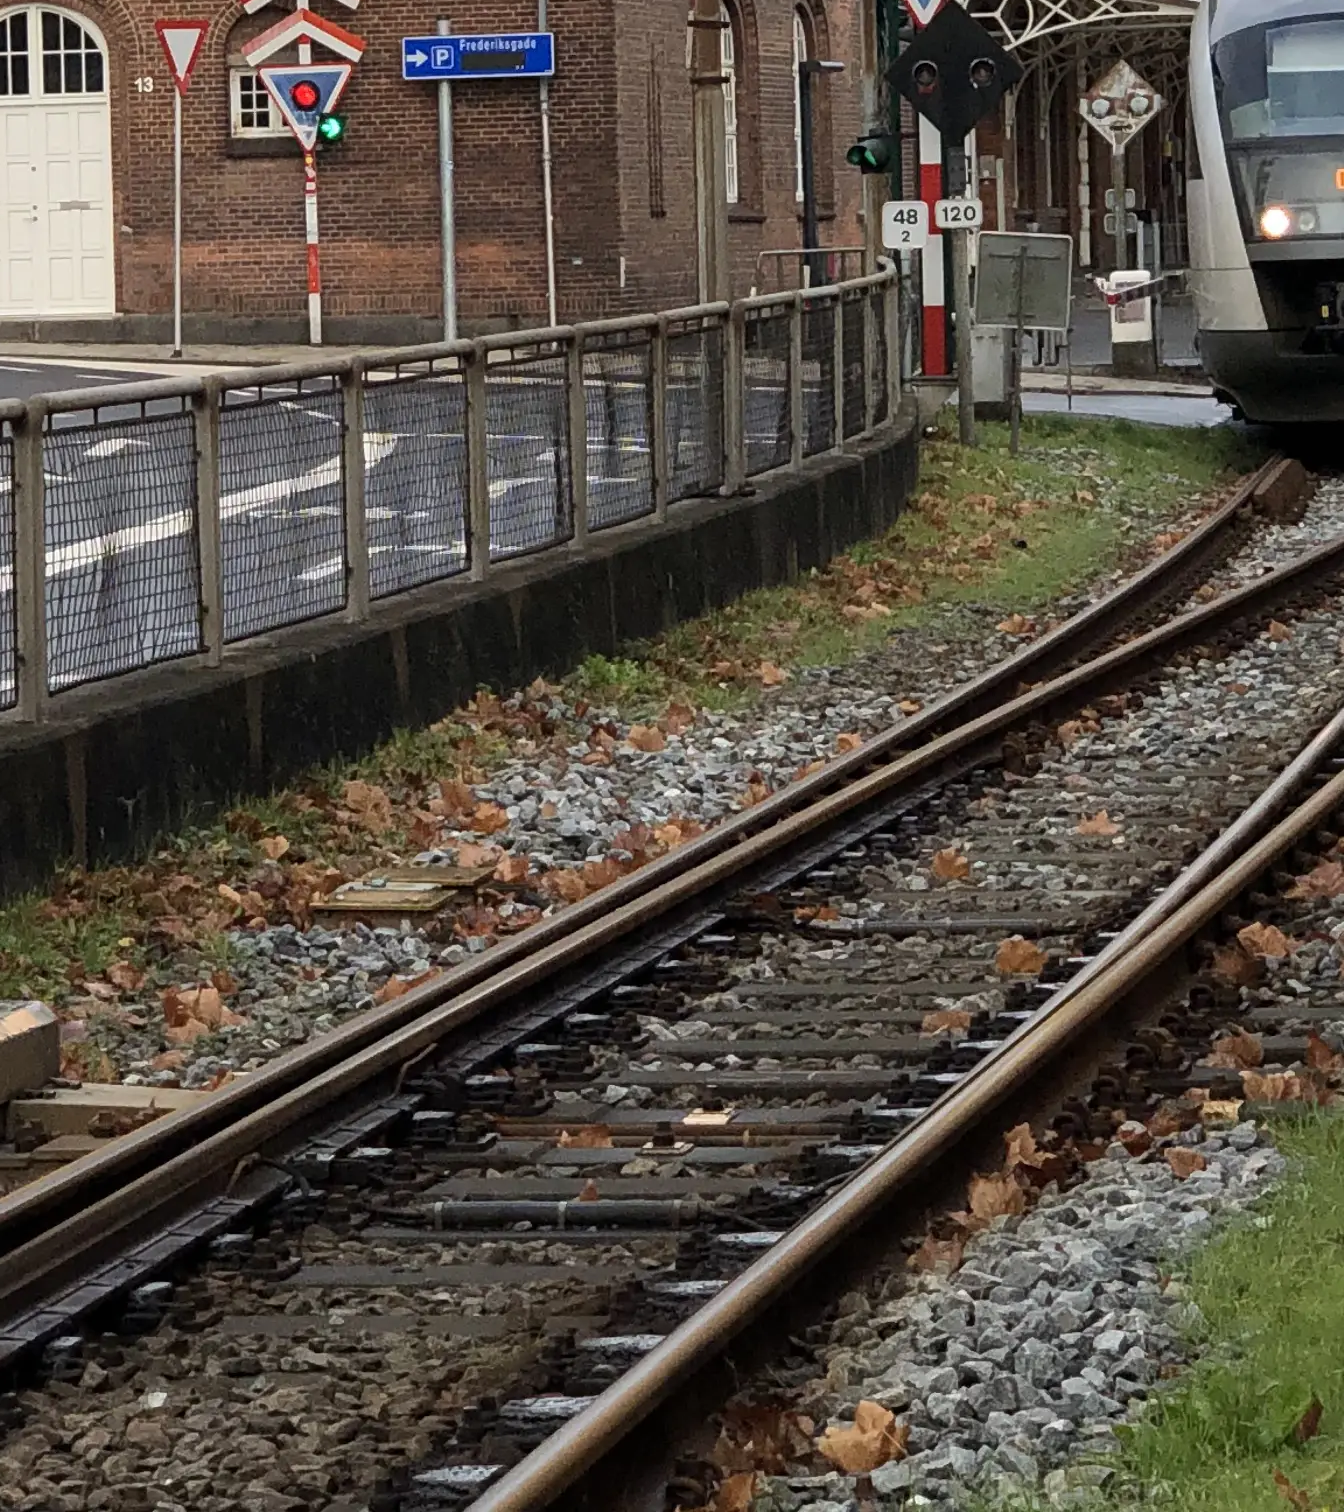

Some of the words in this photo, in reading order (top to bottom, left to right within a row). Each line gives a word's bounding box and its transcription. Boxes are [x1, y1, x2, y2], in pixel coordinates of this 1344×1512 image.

[436, 48, 450, 67] P
[459, 38, 537, 52] Frederiksgade
[134, 76, 154, 93] 13
[893, 208, 918, 225] 48
[941, 205, 976, 222] 120
[901, 230, 911, 243] 2
